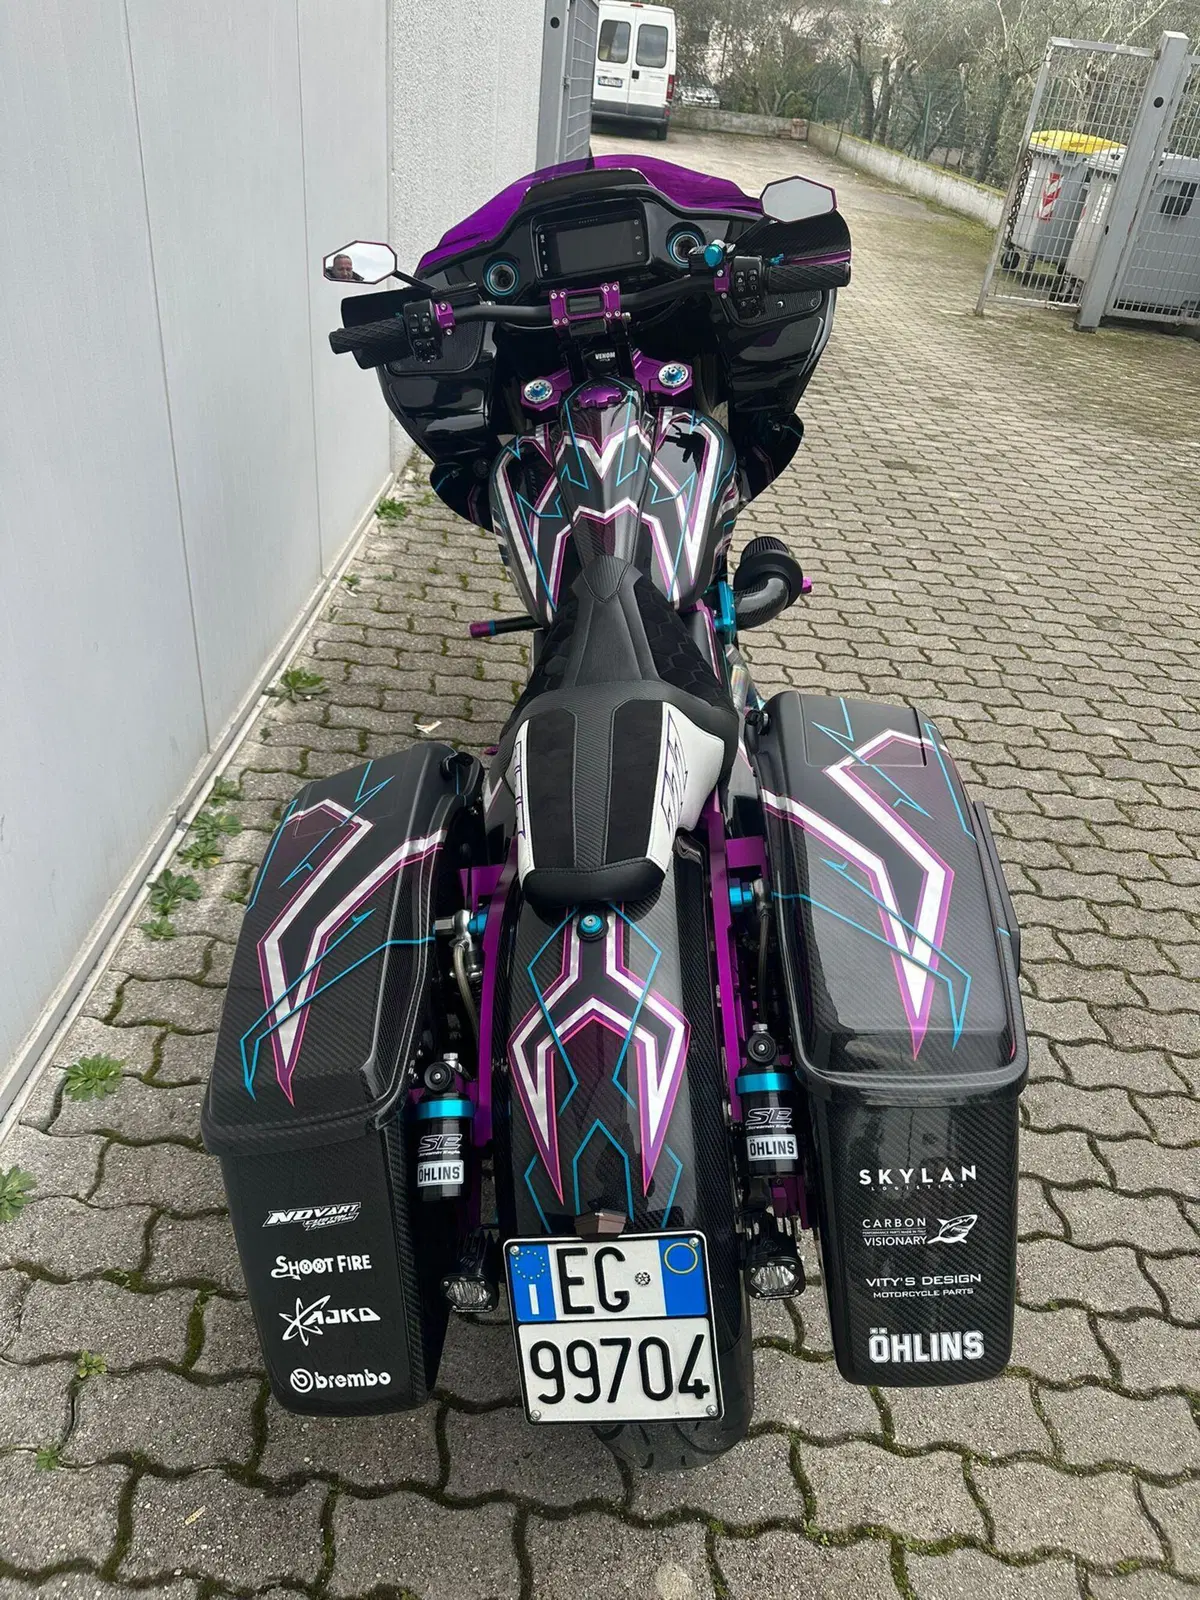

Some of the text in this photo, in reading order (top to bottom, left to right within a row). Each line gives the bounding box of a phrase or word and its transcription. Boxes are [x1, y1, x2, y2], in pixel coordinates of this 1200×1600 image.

[750, 1139, 795, 1156] ÖHLINS
[859, 1165, 977, 1185] SKYLAN
[266, 1204, 359, 1225] NOVART
[862, 1217, 926, 1228] CARBON
[864, 1236, 928, 1247] VISIONARY
[271, 1254, 372, 1280] SHOOT FIRE
[556, 1246, 630, 1314] EG
[866, 1274, 982, 1287] VITY'S DESIGN
[873, 1287, 974, 1299] MOTORCYCLE PARTS
[869, 1327, 985, 1364] ÖHLINS
[314, 1368, 391, 1389] brembo
[530, 1334, 711, 1404] 99704
